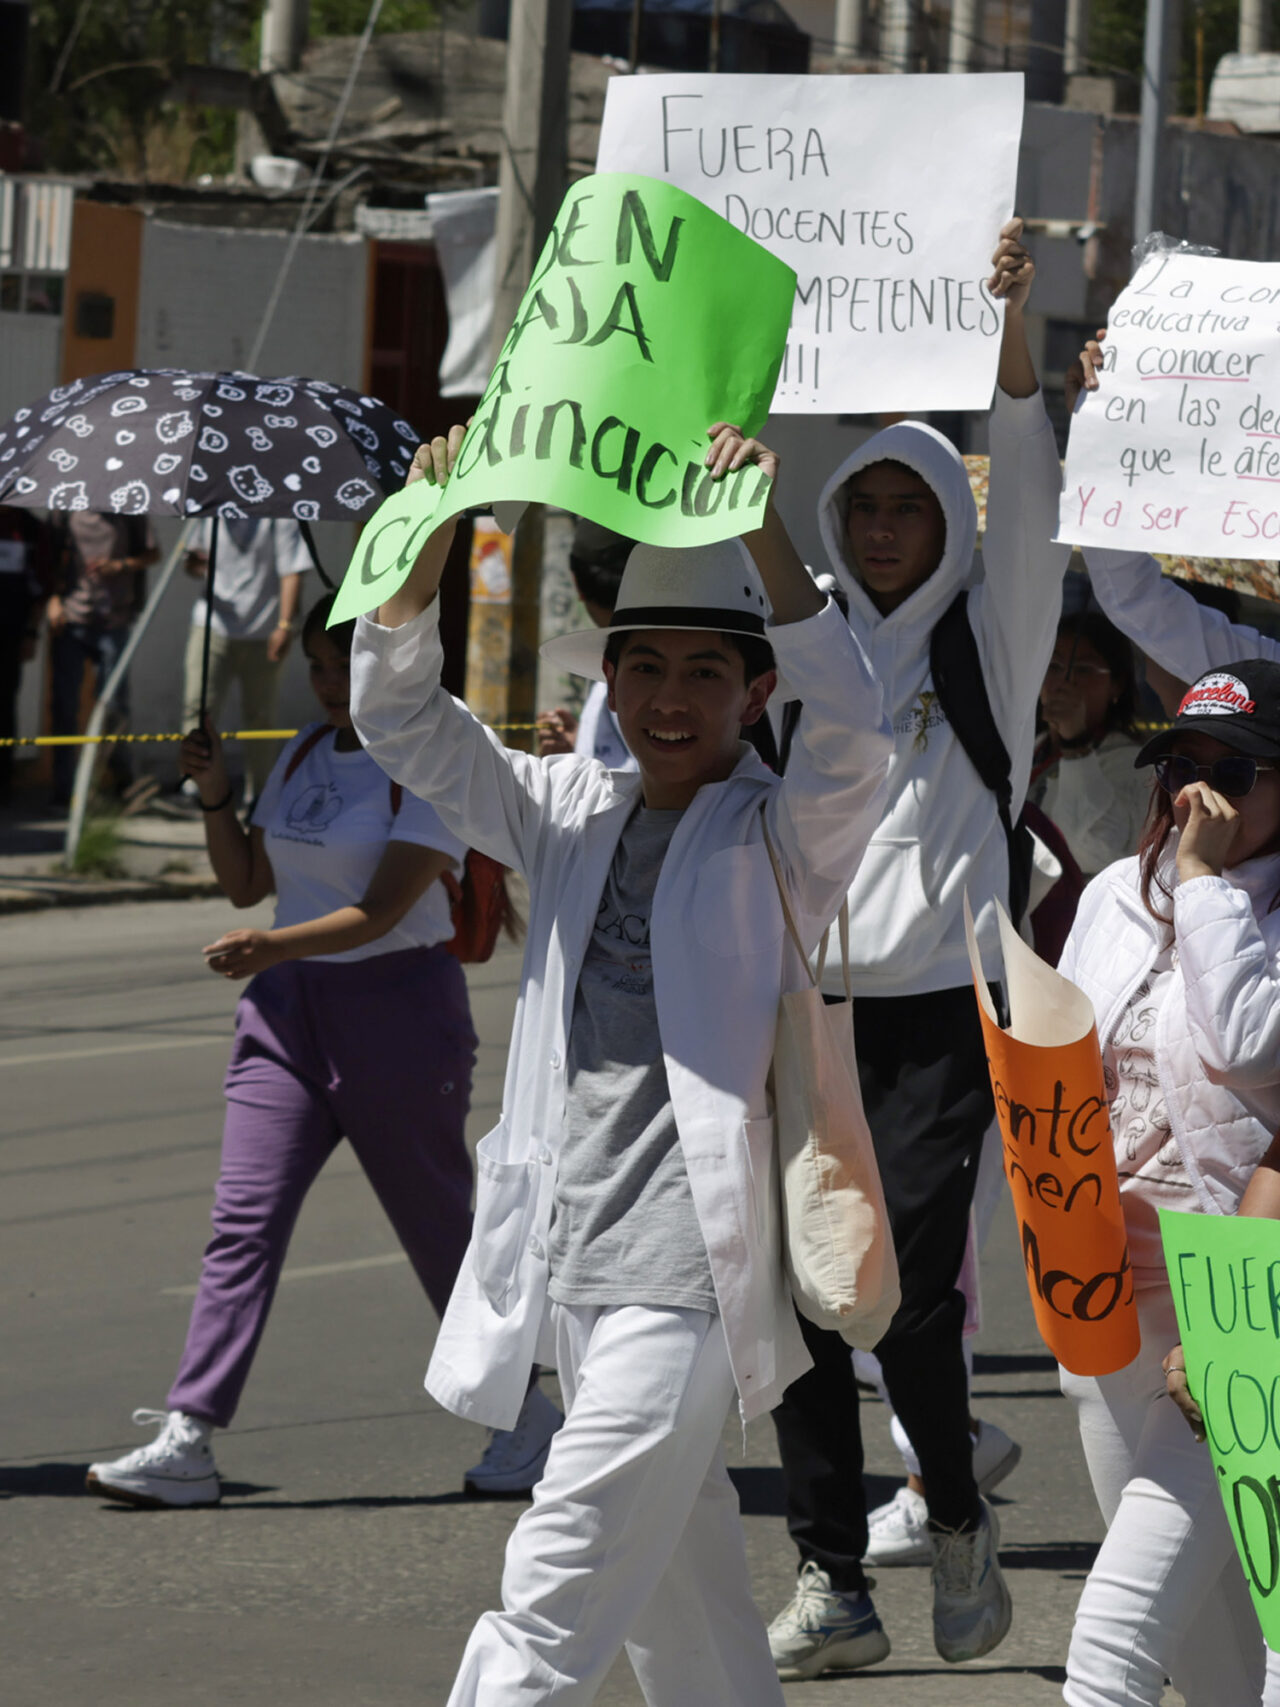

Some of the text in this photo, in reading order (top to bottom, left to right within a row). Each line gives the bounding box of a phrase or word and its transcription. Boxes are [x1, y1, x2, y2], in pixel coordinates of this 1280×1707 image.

[662, 94, 830, 181] FUERA
[724, 193, 915, 255] DOCENTES
[1133, 258, 1193, 299] La
[789, 275, 1000, 337] MPETENTES
[1112, 305, 1250, 335] educativa
[1101, 345, 1118, 374] a
[1136, 345, 1265, 377] conocer
[1105, 395, 1146, 424] en
[1178, 383, 1220, 428] las
[1120, 446, 1175, 487] que
[1199, 438, 1228, 477] le
[1078, 486, 1096, 528] Y
[1103, 499, 1122, 529] a
[1141, 503, 1189, 530] ser
